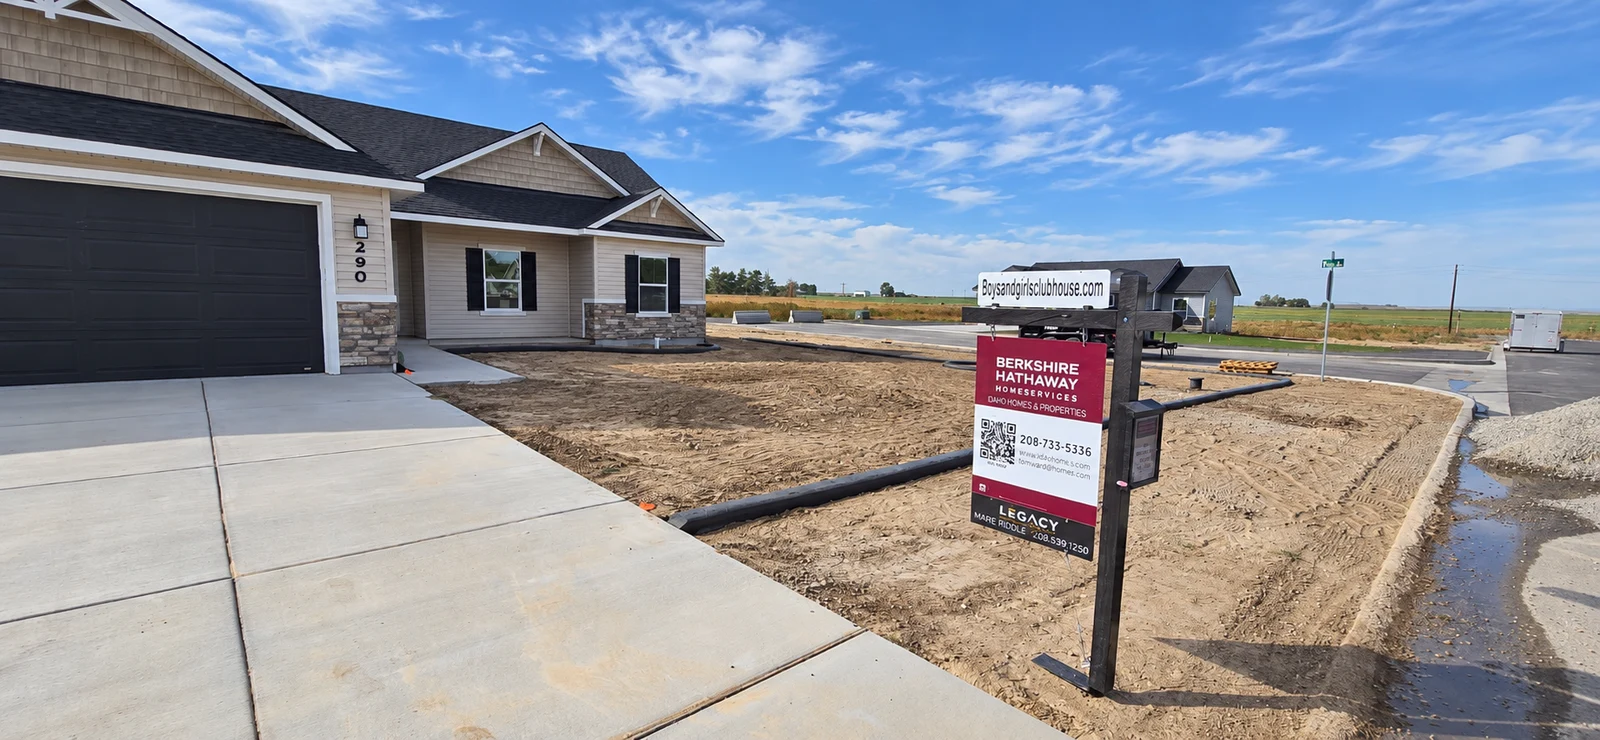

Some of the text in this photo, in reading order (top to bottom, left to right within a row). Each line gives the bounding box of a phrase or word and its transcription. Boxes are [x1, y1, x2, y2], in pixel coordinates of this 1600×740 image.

[355, 241, 367, 283] 290
[982, 278, 1104, 300] Boysandgirlsclubhouse.com
[996, 356, 1080, 376] BERKSHIRE
[995, 370, 1079, 391] HATHAWAY
[995, 385, 1078, 403] HOMESERVICES
[1007, 398, 1033, 410] HOMES
[1033, 402, 1039, 411] &
[1039, 403, 1087, 418] PROPERTIES
[1019, 434, 1092, 457] 208-733-5336
[999, 504, 1059, 532] LEGACY
[974, 511, 1089, 555] MARE RIDDLE 208.539.1250
